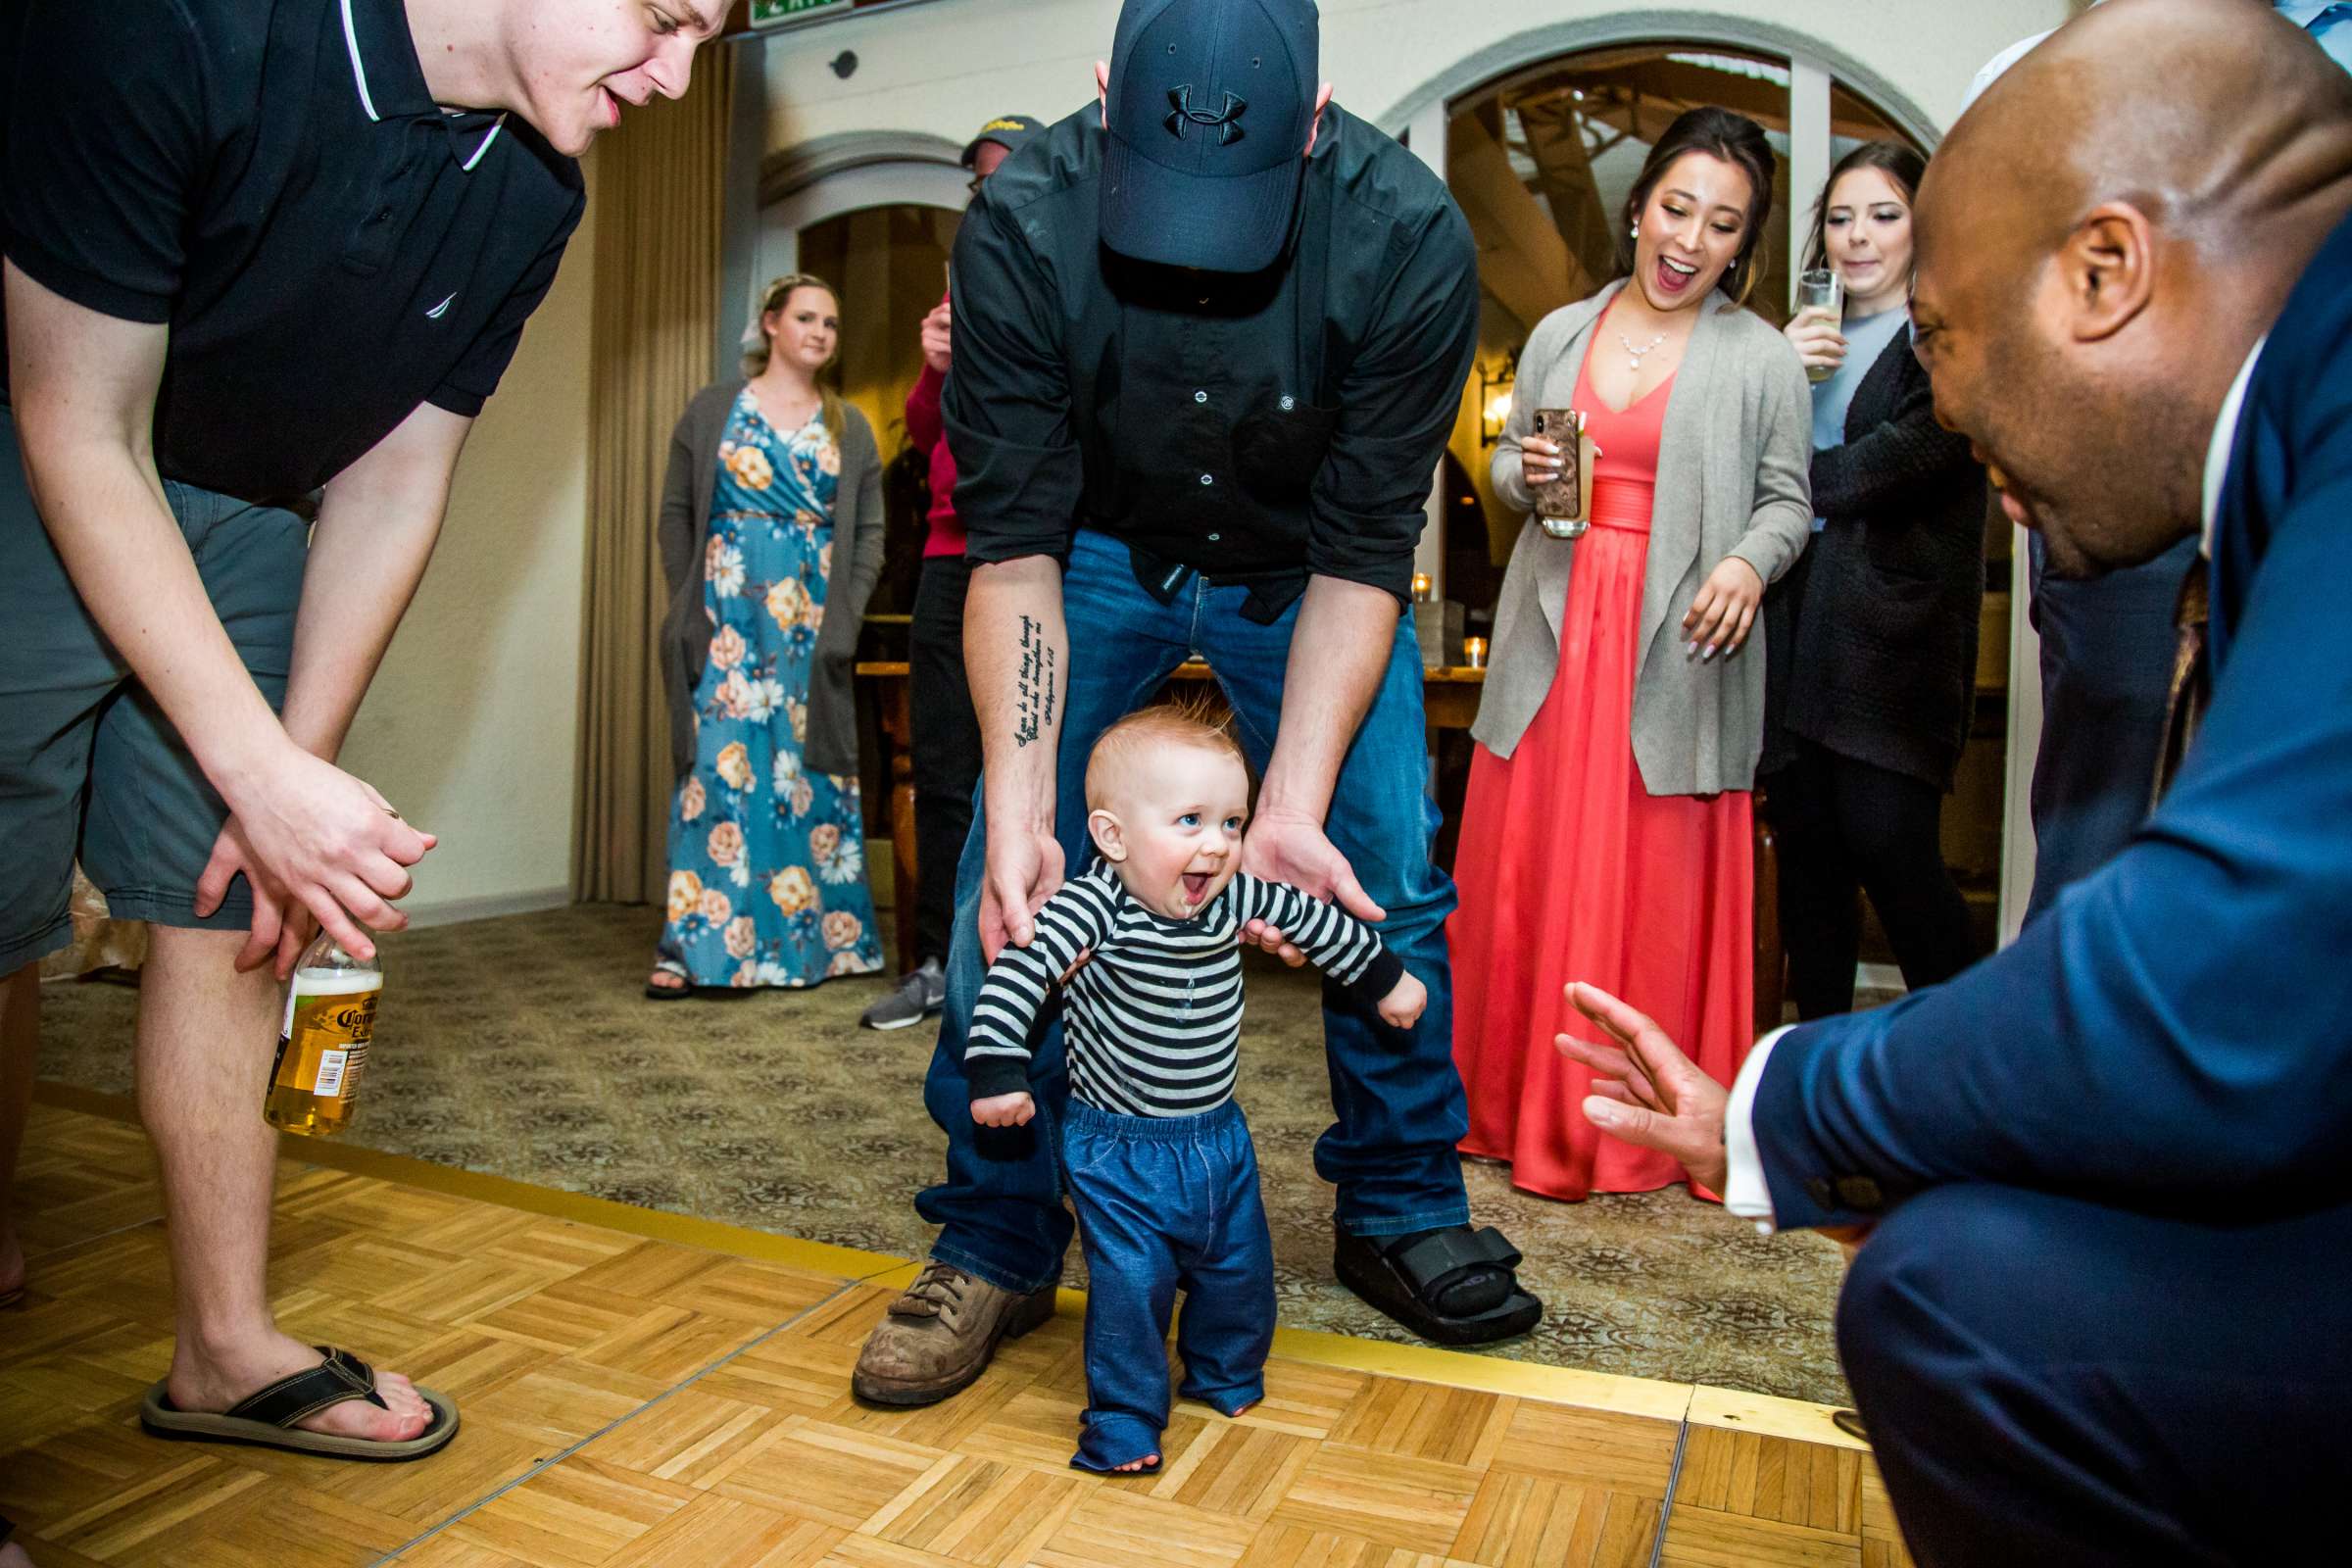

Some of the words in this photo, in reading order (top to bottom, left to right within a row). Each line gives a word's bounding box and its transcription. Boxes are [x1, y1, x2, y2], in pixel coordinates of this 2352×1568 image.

[1019, 615, 1034, 648] through
[1036, 622, 1042, 634] me
[1019, 653, 1033, 678] things
[1018, 681, 1028, 697] all
[1016, 702, 1027, 712] do
[1030, 692, 1039, 709] who
[1026, 711, 1039, 741] Christ
